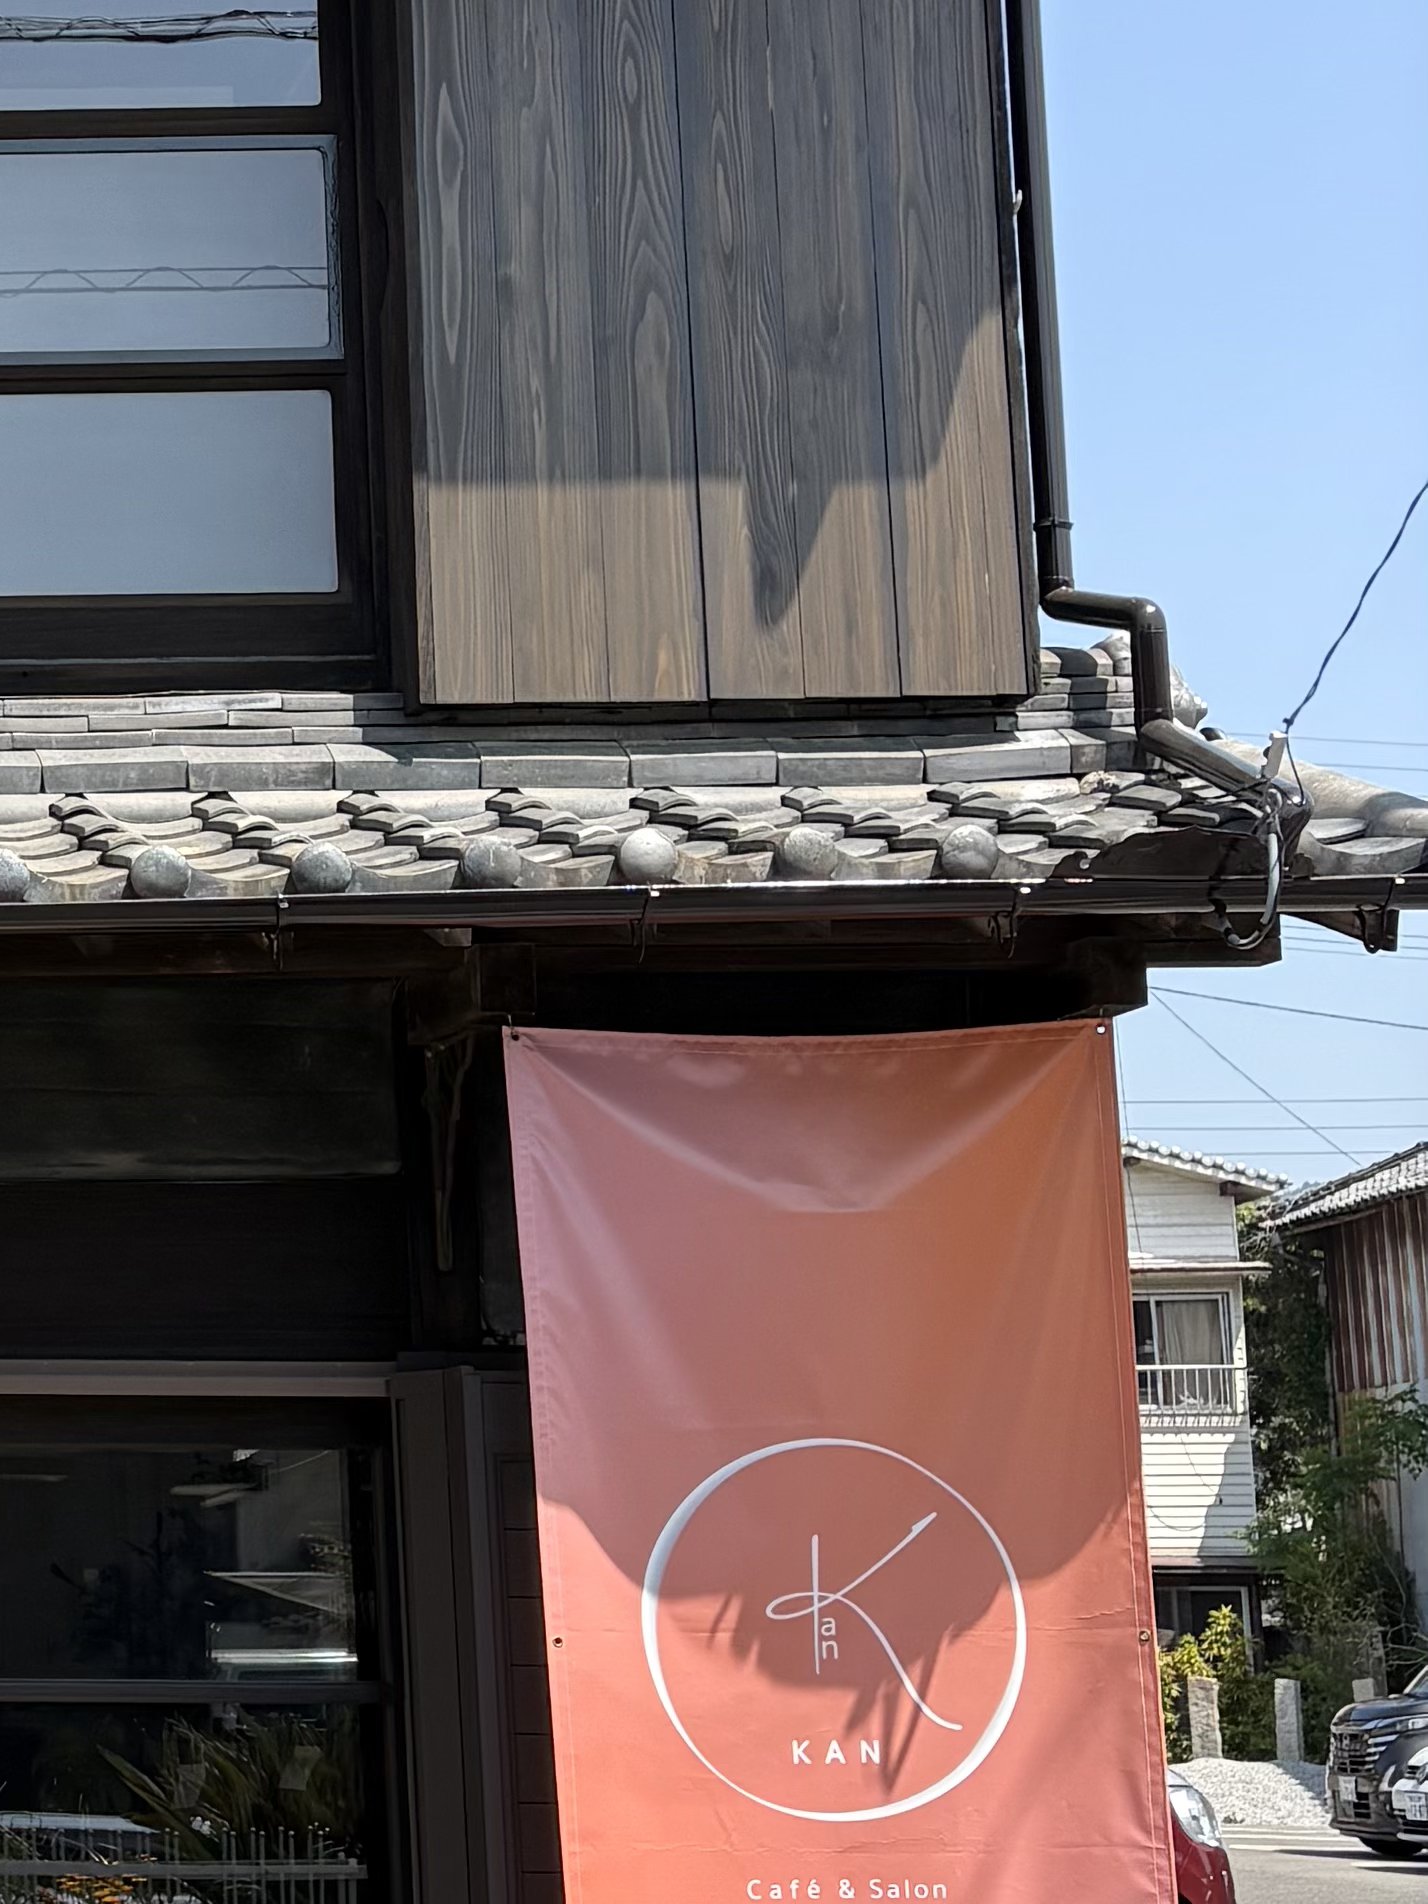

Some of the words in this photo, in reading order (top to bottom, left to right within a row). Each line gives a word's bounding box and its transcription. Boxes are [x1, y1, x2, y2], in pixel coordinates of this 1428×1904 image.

[790, 1739, 882, 1766] KAN
[746, 1878, 821, 1900] Café
[838, 1878, 856, 1900] &
[868, 1878, 948, 1900] Salon
